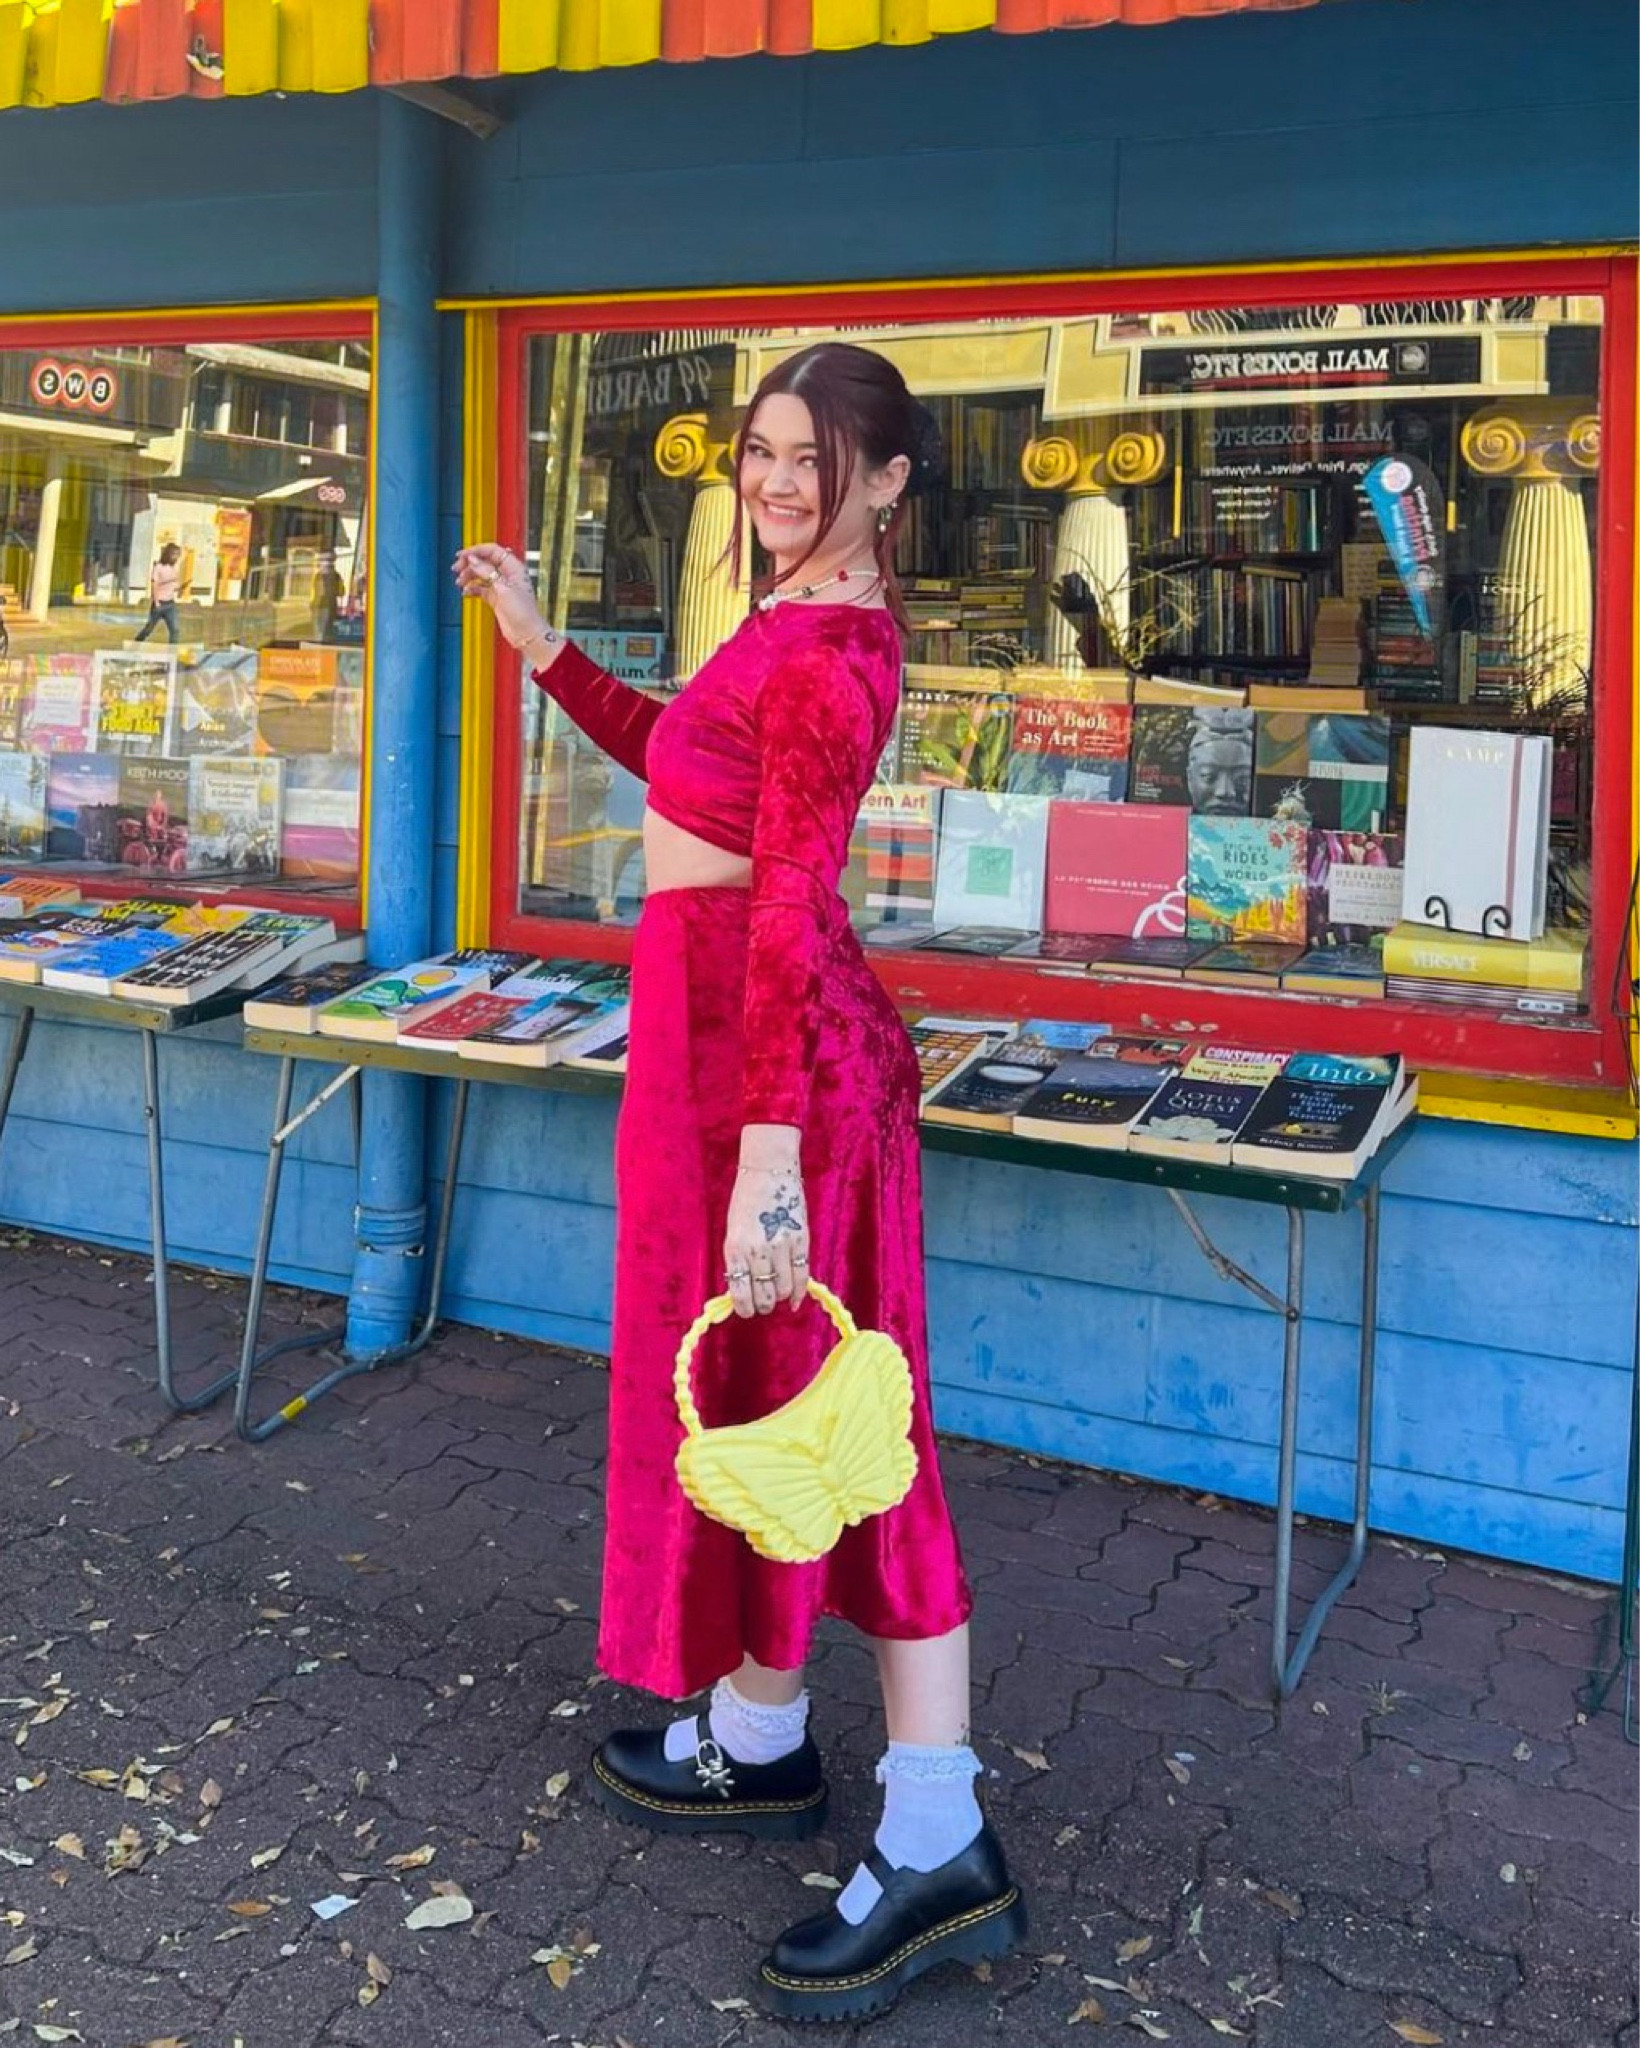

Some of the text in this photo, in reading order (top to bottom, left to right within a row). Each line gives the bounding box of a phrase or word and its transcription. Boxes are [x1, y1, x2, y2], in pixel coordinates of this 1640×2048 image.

[1025, 708, 1108, 730] The Book
[1021, 731, 1043, 744] as
[1048, 730, 1079, 747] Art
[863, 794, 928, 809] ern Art
[1223, 852, 1269, 867] RIDES
[1225, 869, 1268, 882] WORLD
[1205, 1047, 1292, 1066] CONSPIRACY
[1306, 1062, 1377, 1083] Into
[1061, 1092, 1118, 1109] Fury
[1175, 1087, 1241, 1105] LOTUS
[1167, 1096, 1235, 1114] QUEST
